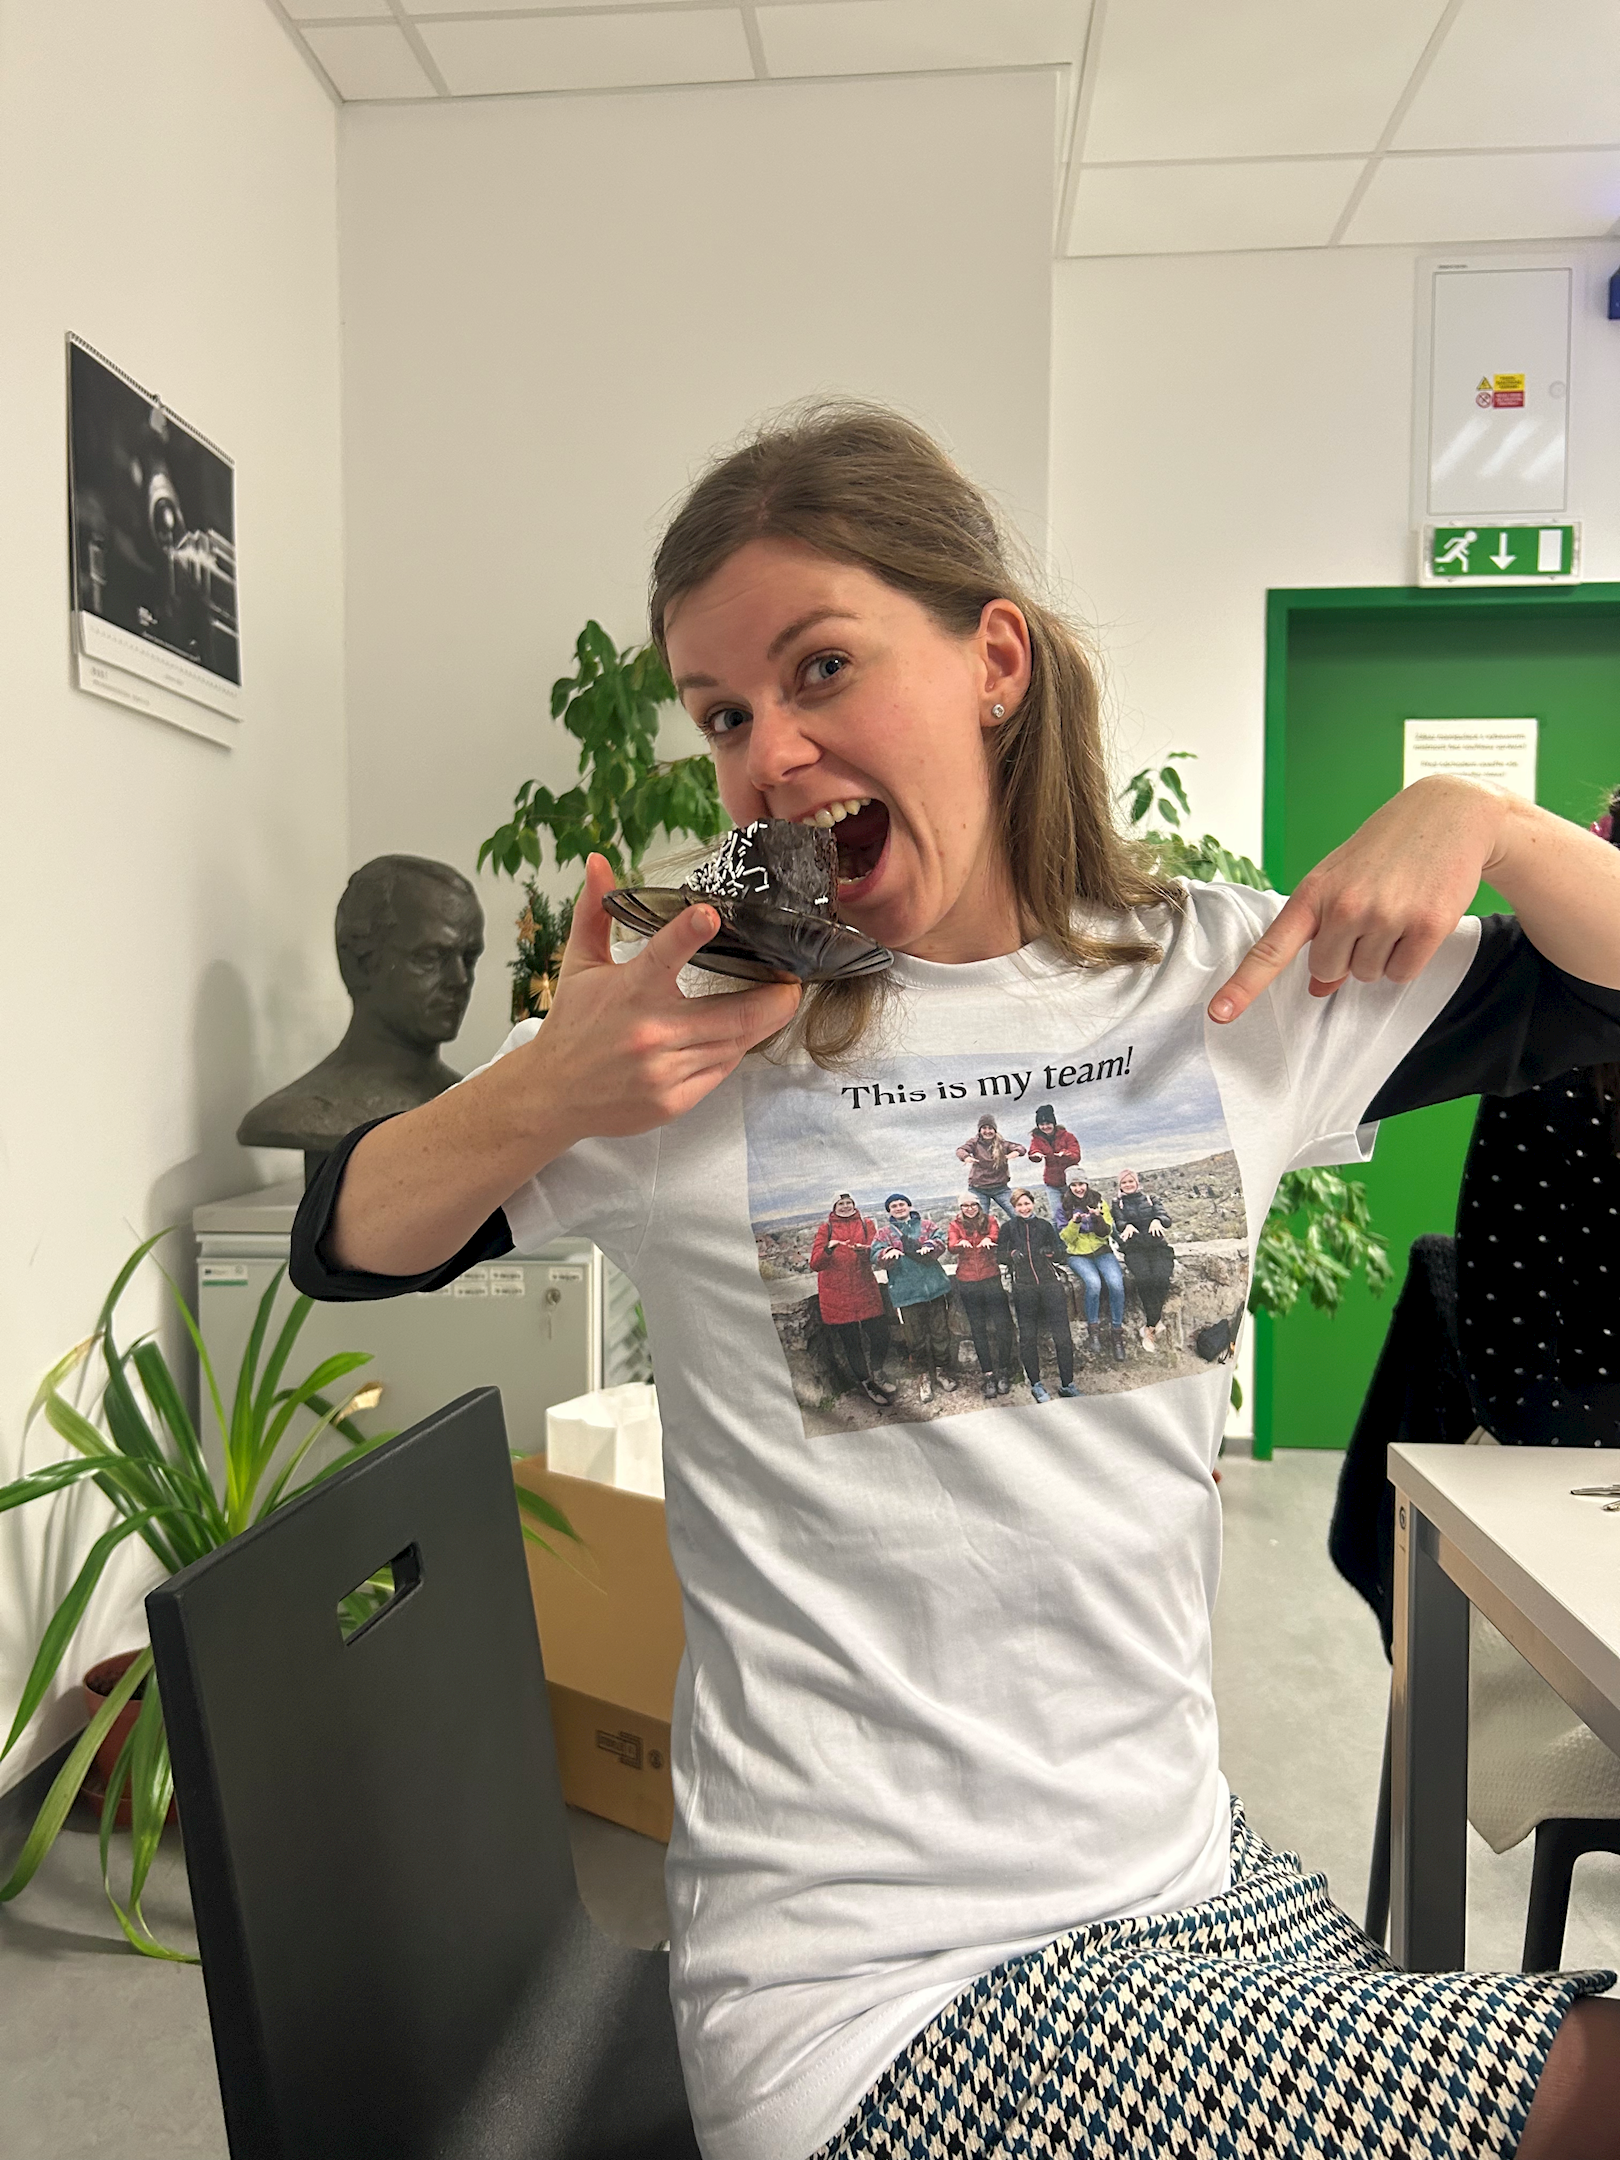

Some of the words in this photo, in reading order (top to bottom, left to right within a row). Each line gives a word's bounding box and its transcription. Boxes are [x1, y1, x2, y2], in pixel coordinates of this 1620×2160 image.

[841, 1083, 927, 1110] This
[936, 1081, 967, 1100] is
[977, 1070, 1032, 1101] my
[1043, 1046, 1134, 1090] team!
